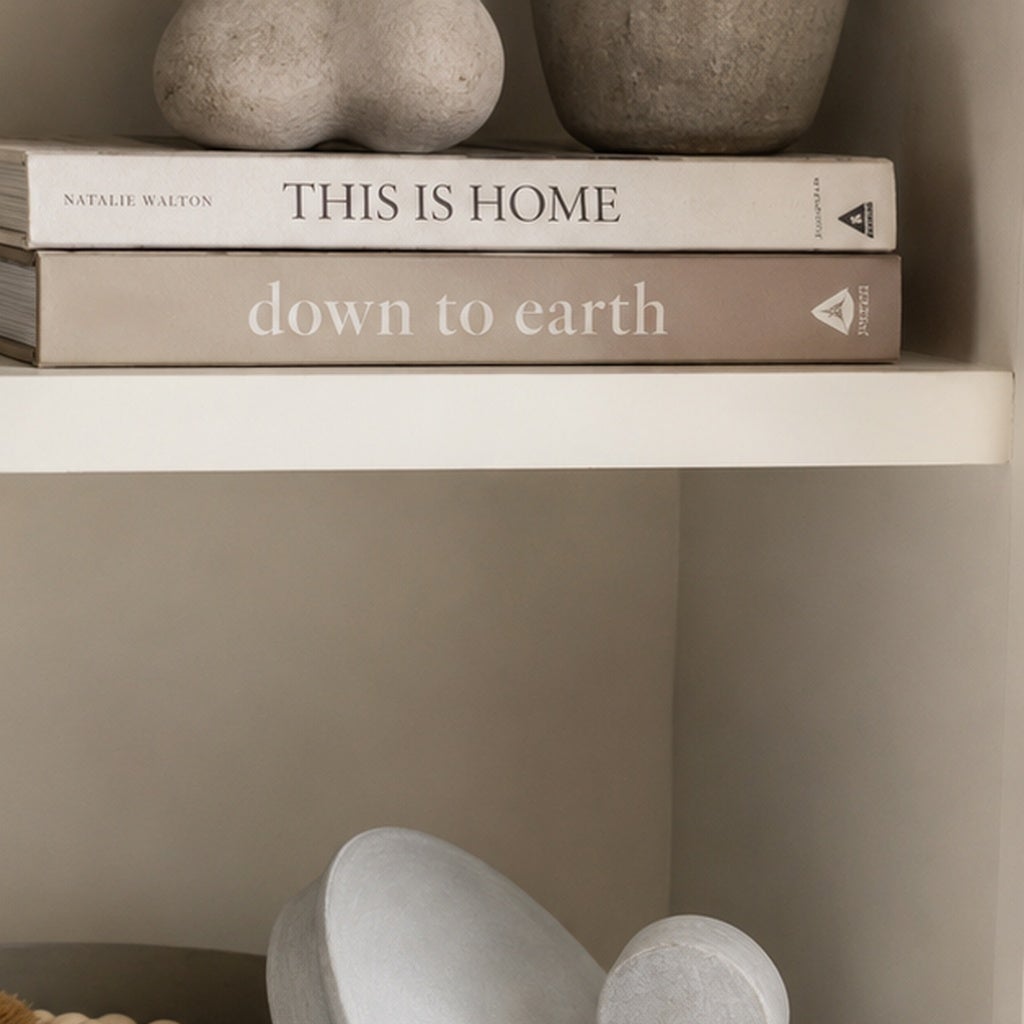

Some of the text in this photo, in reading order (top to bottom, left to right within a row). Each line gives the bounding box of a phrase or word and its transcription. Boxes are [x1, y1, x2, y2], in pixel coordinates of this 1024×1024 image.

[64, 194, 212, 207] NATALIE WALTON
[283, 183, 621, 222] THIS IS HOME
[248, 281, 667, 336] down to earth
